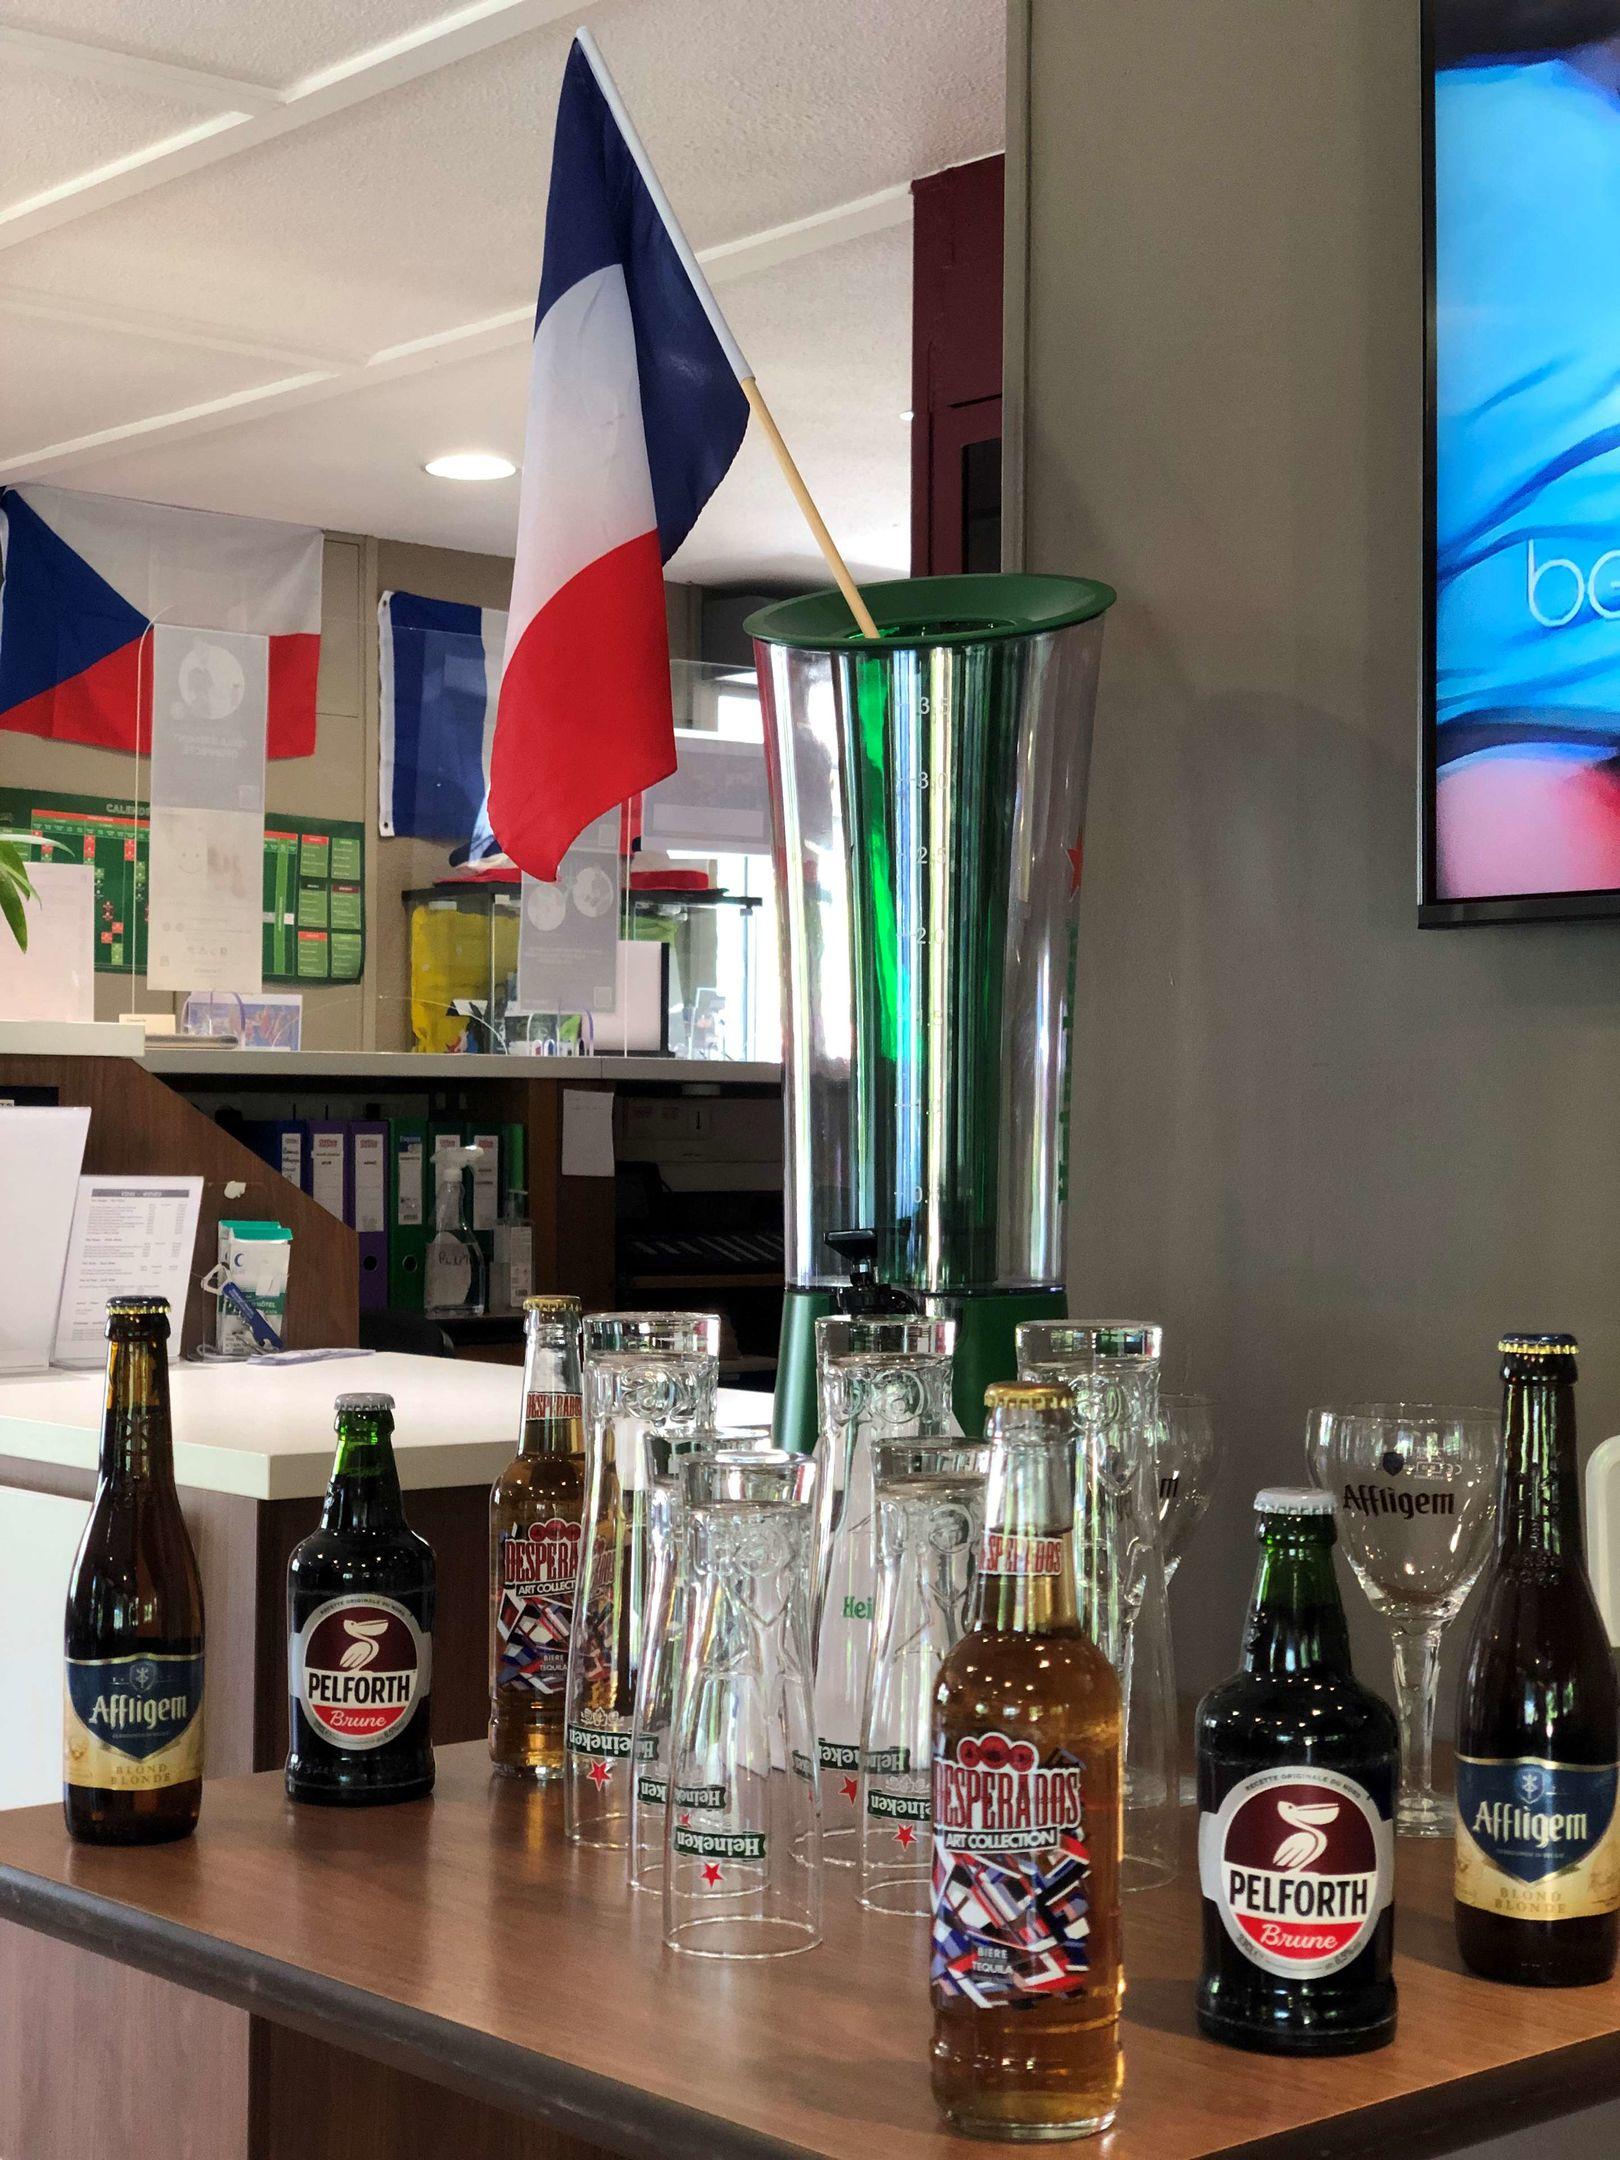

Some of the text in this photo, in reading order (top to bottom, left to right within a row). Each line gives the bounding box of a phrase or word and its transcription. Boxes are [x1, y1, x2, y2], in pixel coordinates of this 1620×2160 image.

[1343, 1484, 1455, 1519] Affligem
[504, 1538, 579, 1582] DESPERA
[518, 1582, 575, 1595] ART COLLECT
[308, 1673, 410, 1704] PELFORTH
[88, 1694, 187, 1730] Affligem
[329, 1710, 387, 1727] Brune
[110, 1773, 171, 1786] BLONDE
[116, 1763, 167, 1775] BLOND
[934, 1758, 1080, 1829] DESPERADOS
[1245, 1774, 1279, 1792] RECETTE
[1281, 1773, 1328, 1784] ORIGINALE
[870, 1795, 932, 1818] eineken
[1472, 1800, 1587, 1849] Affligem
[676, 1831, 760, 1856] Heineken
[946, 1830, 1055, 1849] ART COLLECTION
[1229, 1869, 1368, 1917] PELFORTH
[1500, 1886, 1563, 1902] BLOND
[1494, 1897, 1568, 1914] BLONDE
[1260, 1923, 1338, 1949] Brune
[972, 1960, 1014, 1975] TEQUILA
